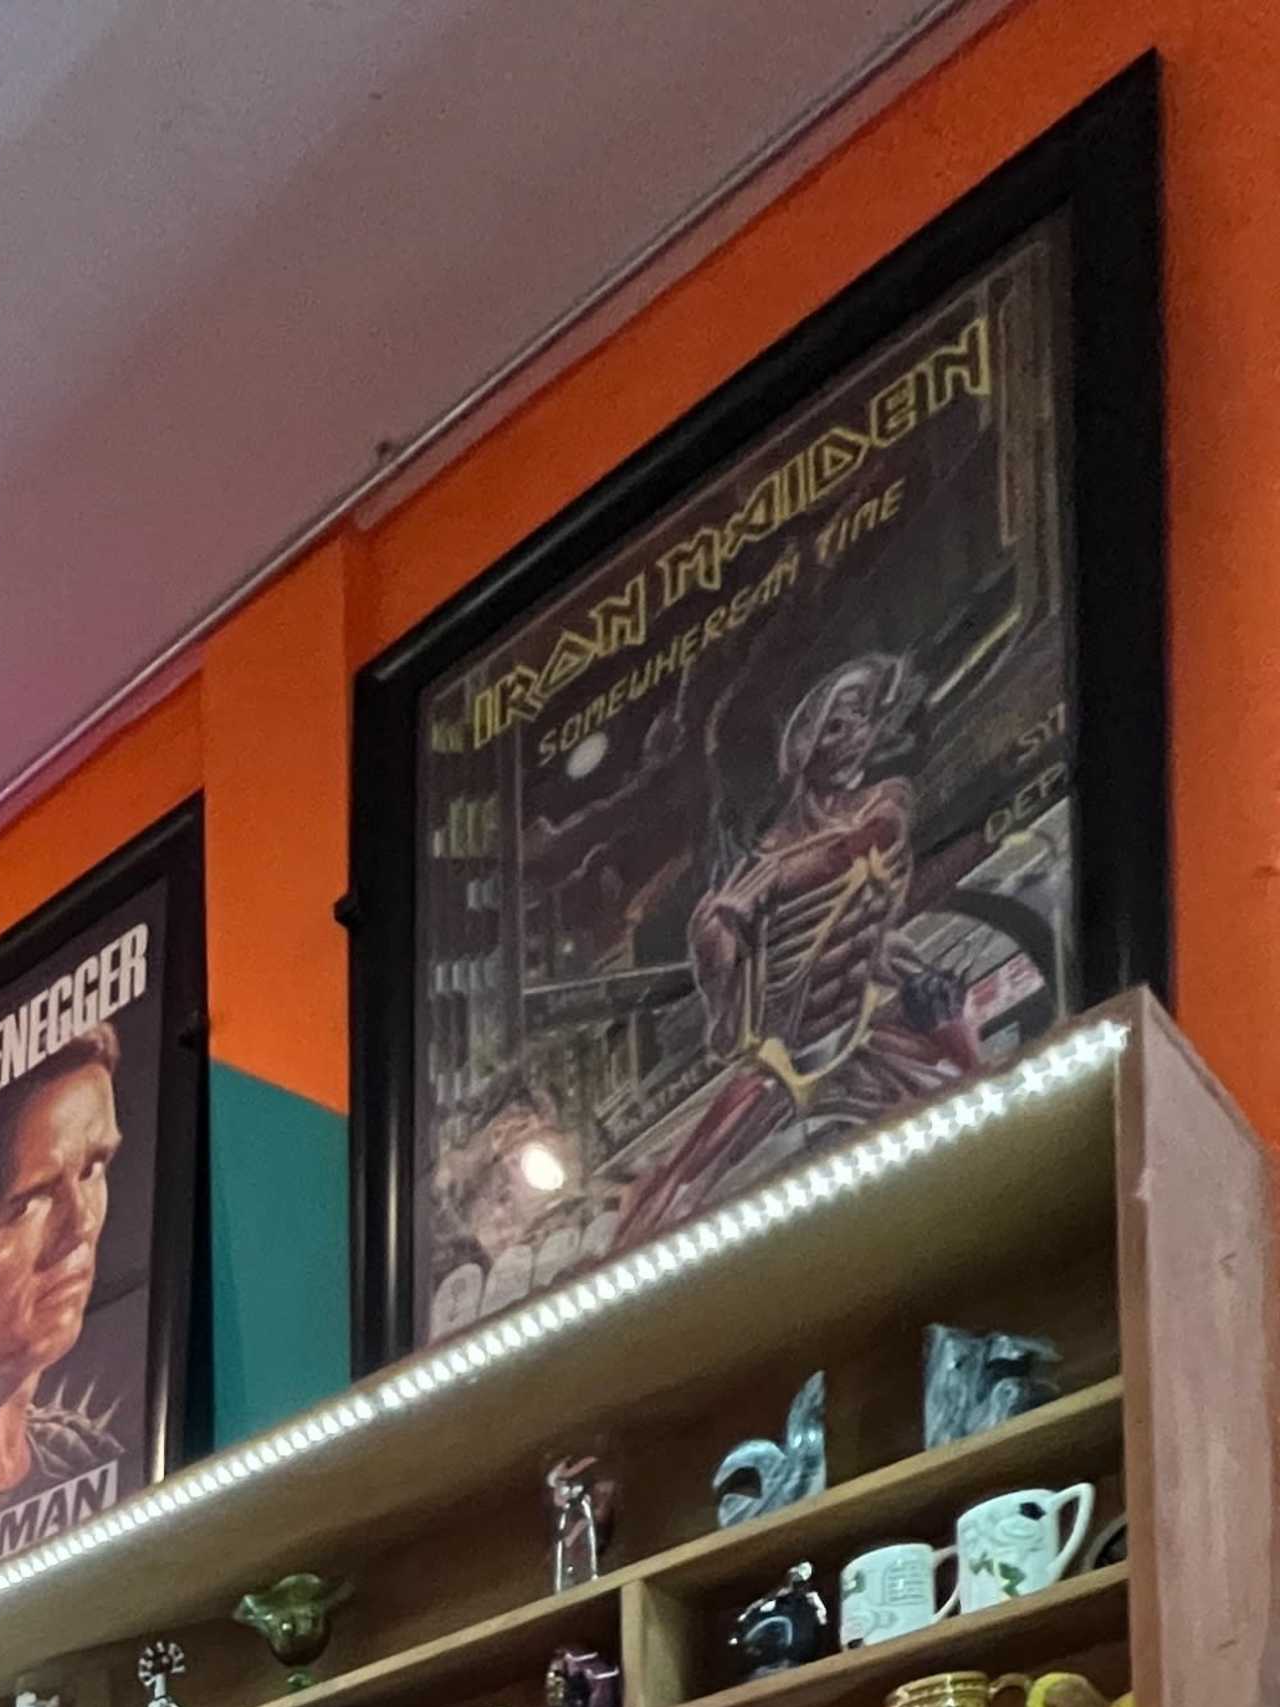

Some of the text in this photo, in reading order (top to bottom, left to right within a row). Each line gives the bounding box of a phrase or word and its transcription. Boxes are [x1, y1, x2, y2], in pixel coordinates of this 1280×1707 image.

[474, 315, 990, 749] IRON MAIDEN
[815, 480, 904, 564] TIME
